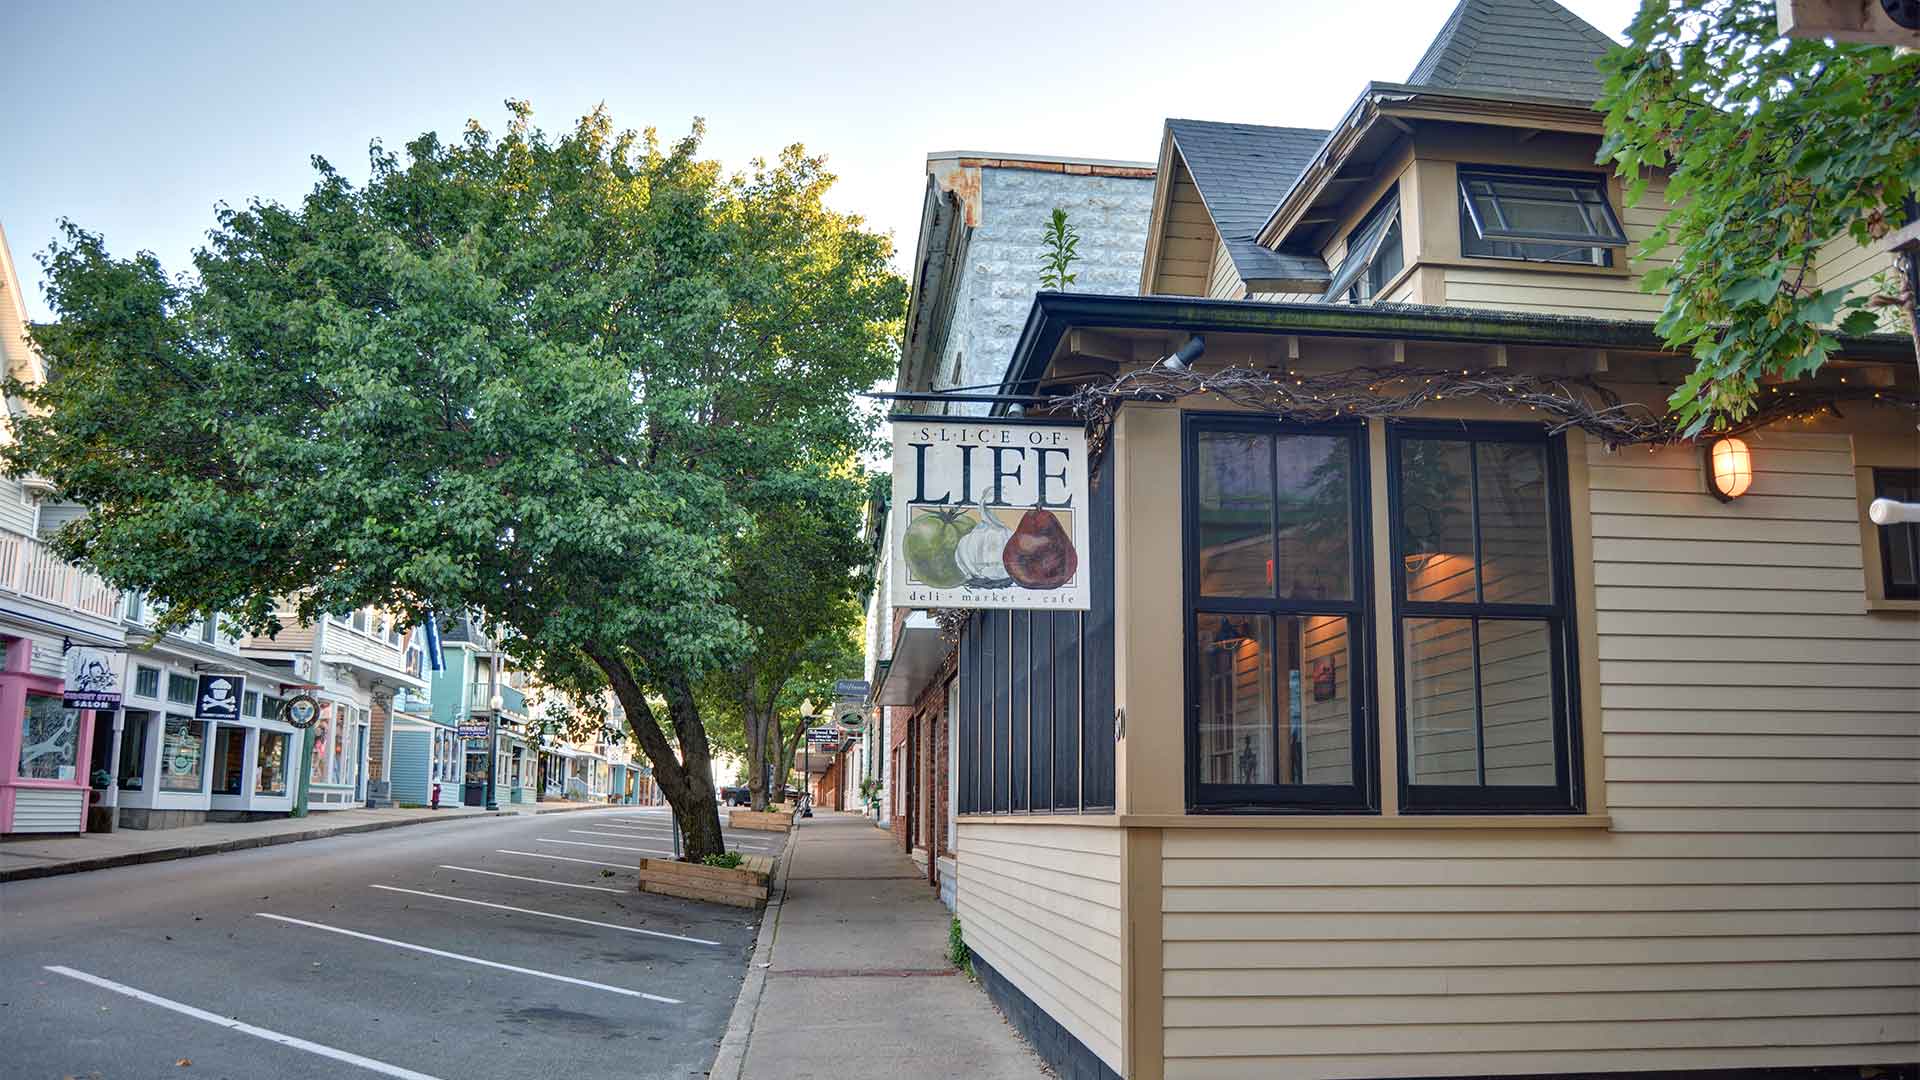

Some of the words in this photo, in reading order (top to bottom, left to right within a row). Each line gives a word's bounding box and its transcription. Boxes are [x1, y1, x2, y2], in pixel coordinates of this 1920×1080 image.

[907, 443, 1073, 507] LIFE
[909, 591, 939, 601] deli
[962, 592, 1016, 603] market
[72, 700, 109, 709] SALON
